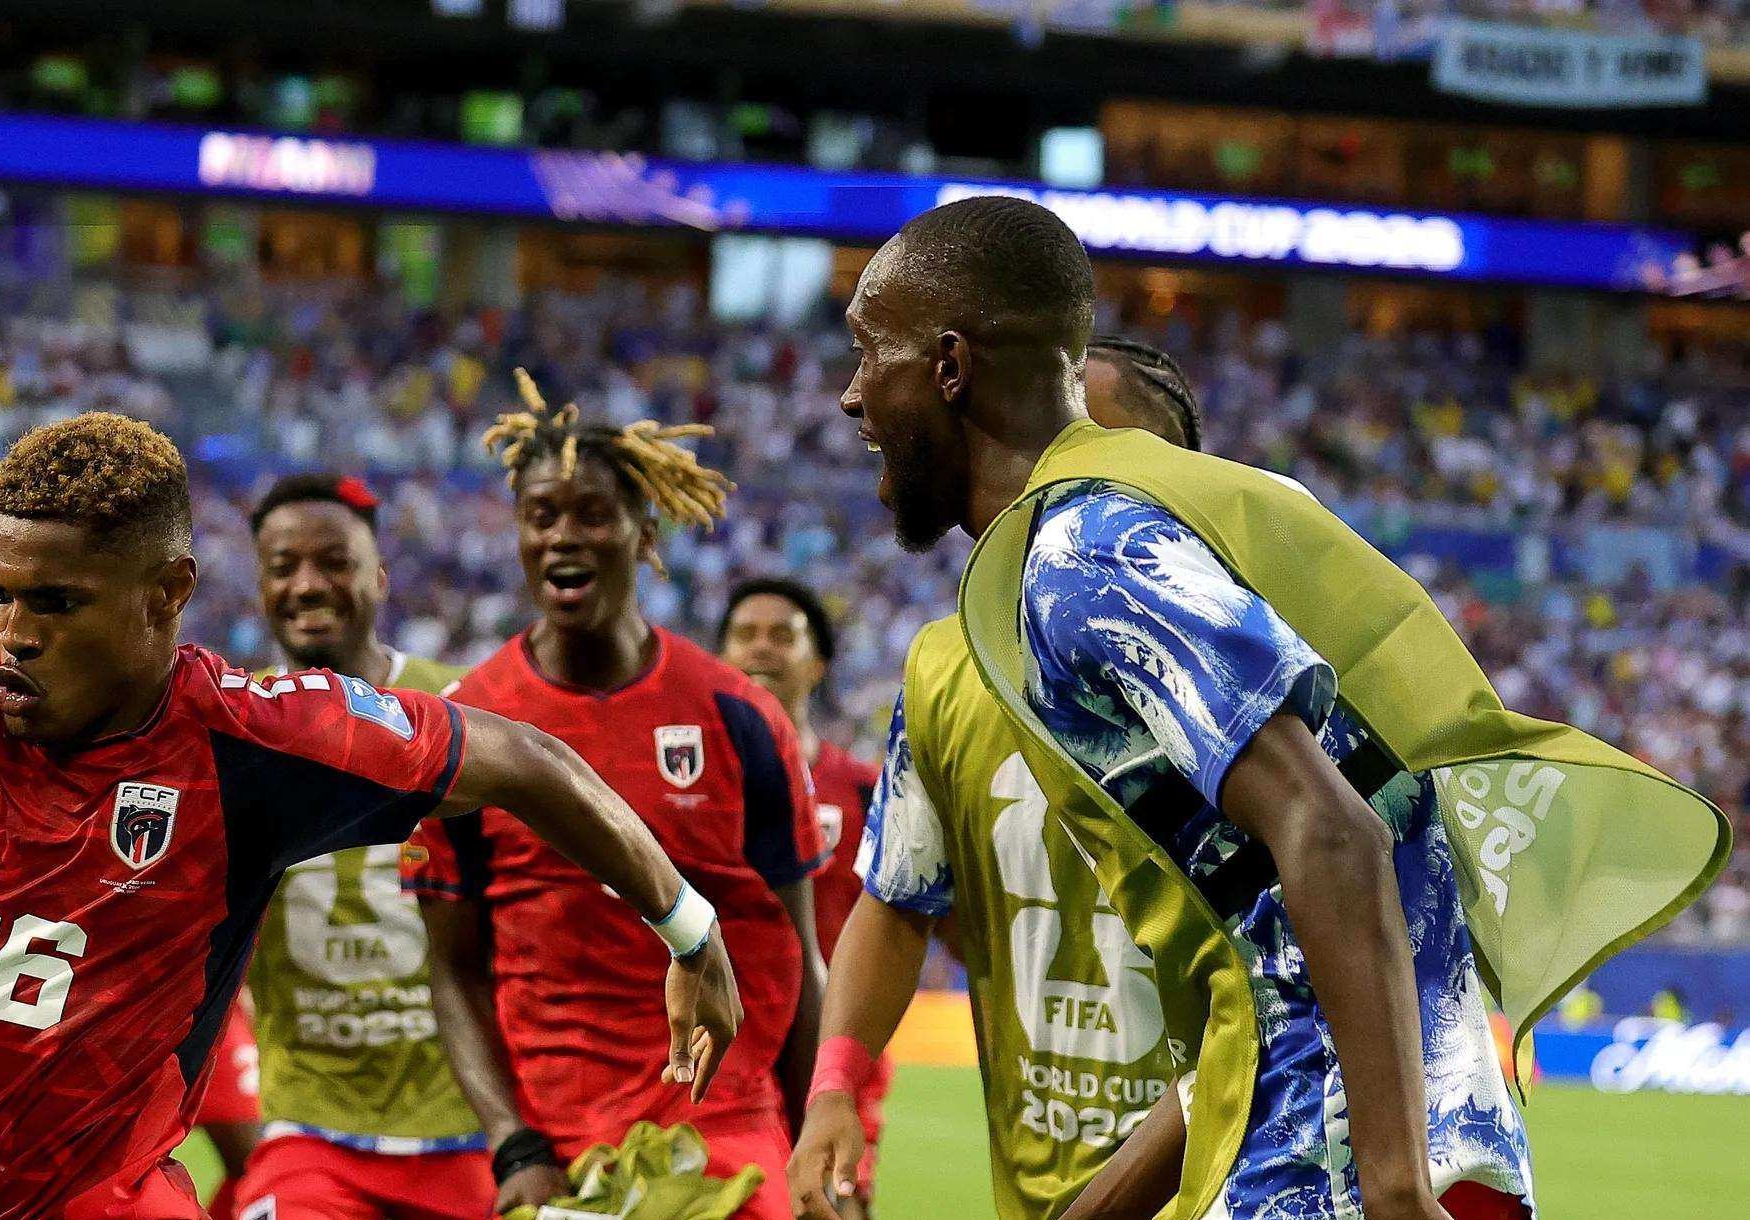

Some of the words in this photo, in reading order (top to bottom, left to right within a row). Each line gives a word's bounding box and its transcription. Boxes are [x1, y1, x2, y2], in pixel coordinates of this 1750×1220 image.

[122, 785, 174, 801] FCF
[1043, 995, 1119, 1034] FIFA
[1103, 1074, 1168, 1105] CUP
